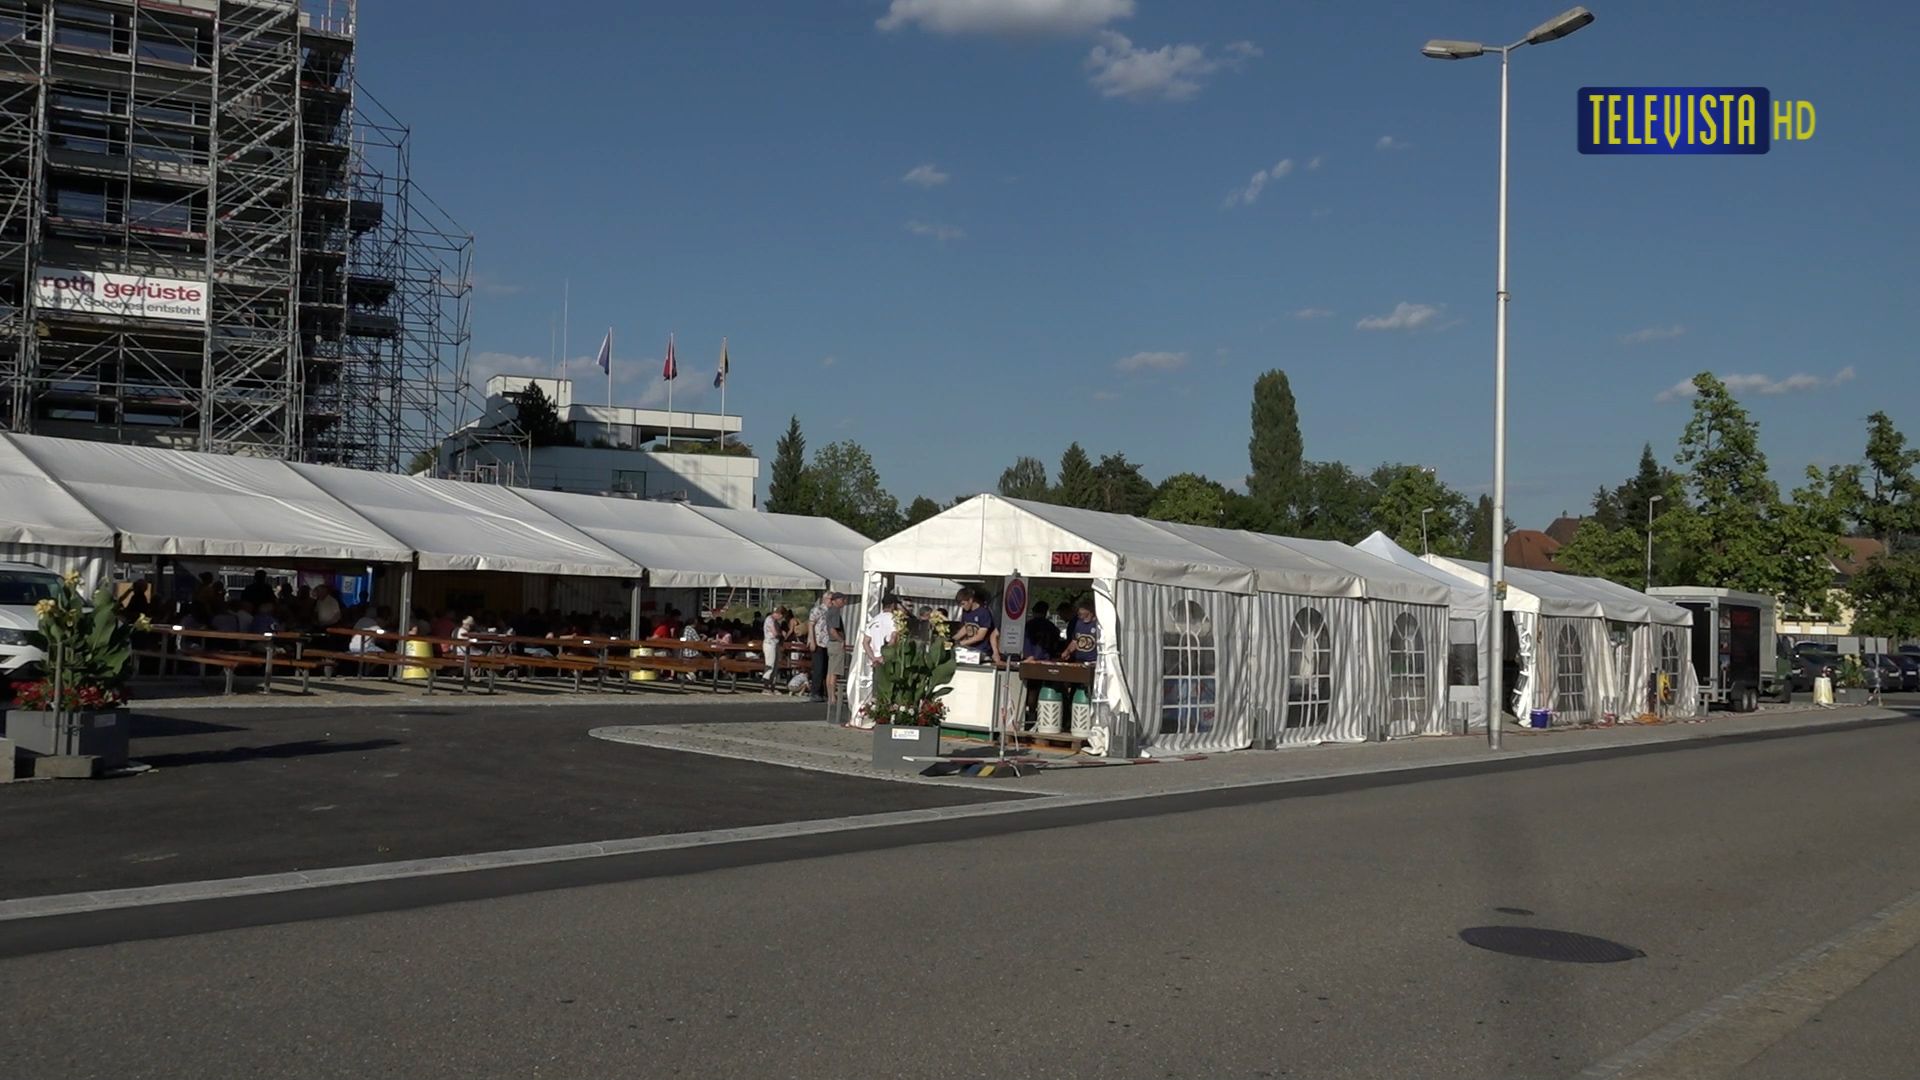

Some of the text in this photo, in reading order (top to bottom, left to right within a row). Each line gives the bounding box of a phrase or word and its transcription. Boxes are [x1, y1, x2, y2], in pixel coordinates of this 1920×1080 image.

[42, 276, 201, 302] roth gerüste
[146, 303, 202, 316] entsteht
